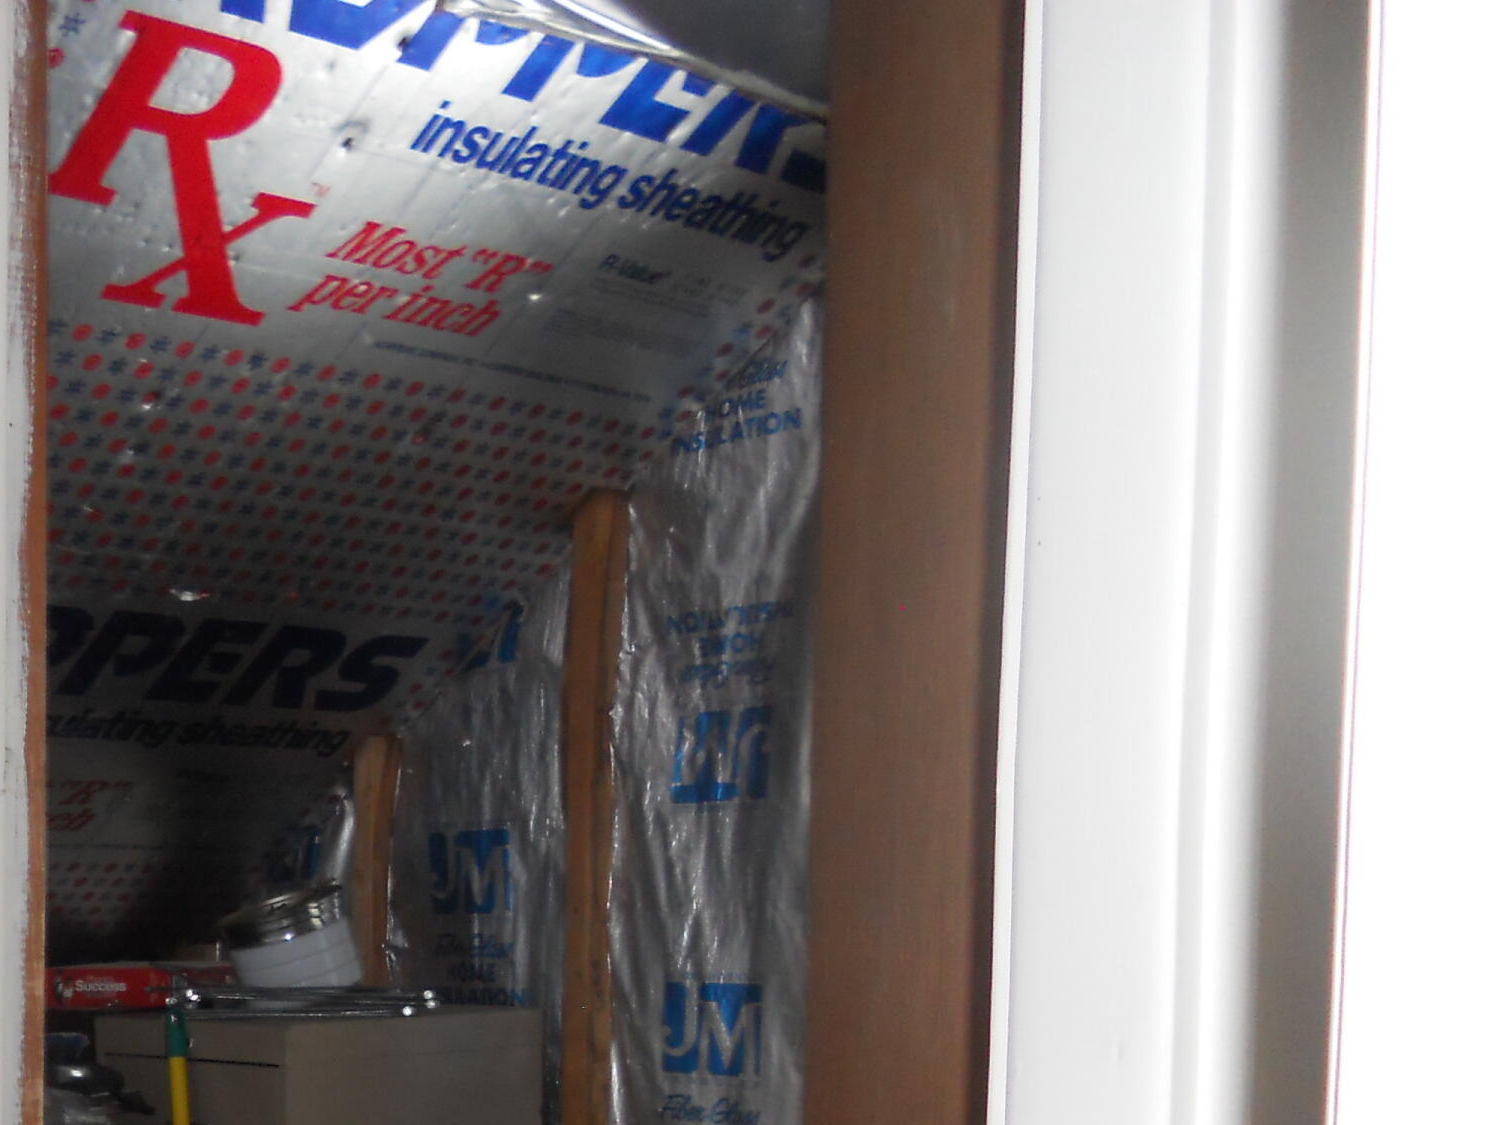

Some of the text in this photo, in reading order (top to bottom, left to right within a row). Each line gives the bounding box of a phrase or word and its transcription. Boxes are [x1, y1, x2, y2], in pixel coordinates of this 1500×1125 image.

[411, 100, 806, 263] insulating sheathing
[326, 221, 467, 280] Most
[287, 275, 399, 314] per
[383, 285, 501, 336] inch
[428, 828, 511, 915] JM
[662, 980, 764, 1078] JM
